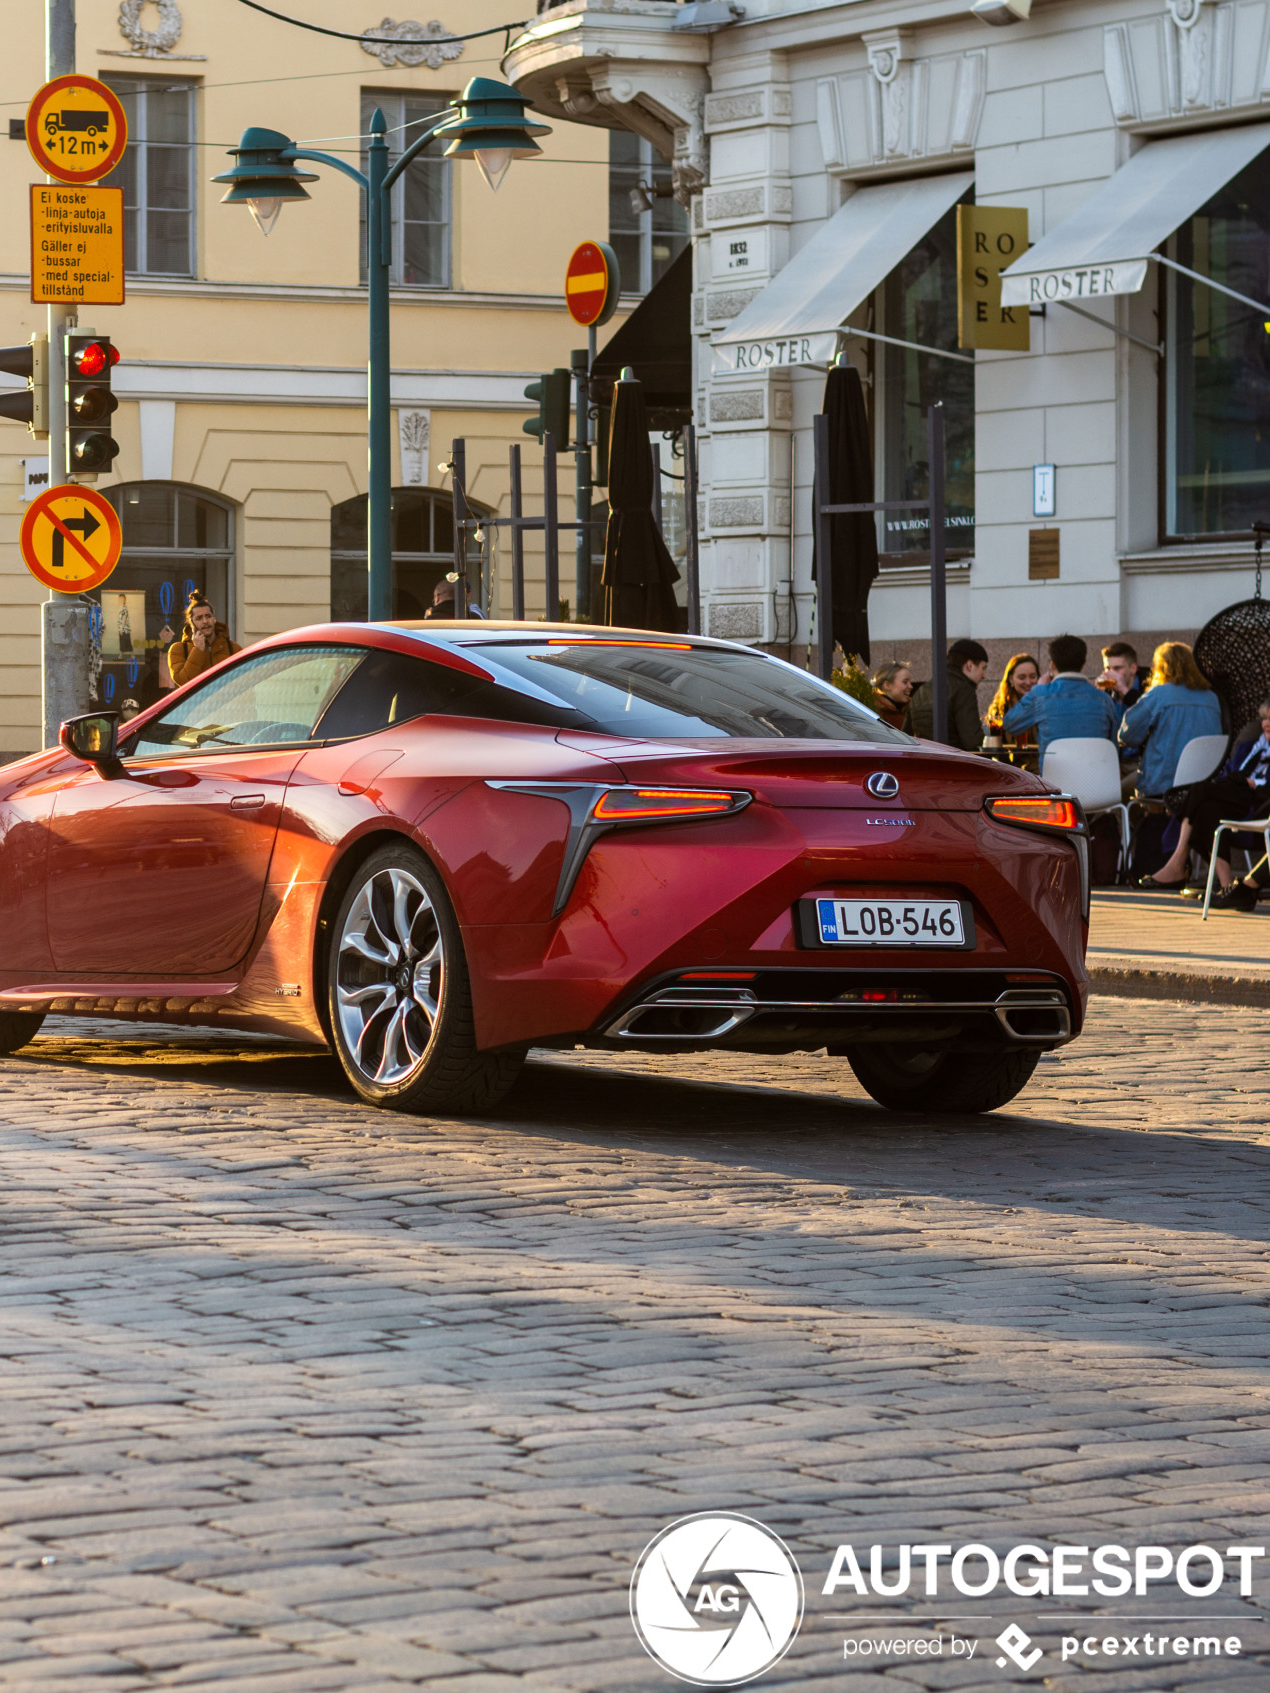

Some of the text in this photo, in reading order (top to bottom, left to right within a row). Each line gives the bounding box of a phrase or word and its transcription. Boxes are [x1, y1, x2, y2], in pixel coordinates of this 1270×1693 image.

[41, 191, 87, 204] Ei koske
[41, 206, 106, 221] -linja-autoja
[41, 221, 113, 234] -erityisluvalla
[41, 240, 87, 254] Gäller ej
[730, 241, 748, 255] 1832
[41, 255, 81, 267] -bussar
[41, 270, 115, 284] -med special-
[42, 284, 85, 296] tillstånd
[1030, 268, 1115, 302] ROSTER
[736, 338, 812, 369] ROSTER
[822, 924, 837, 934] FIN
